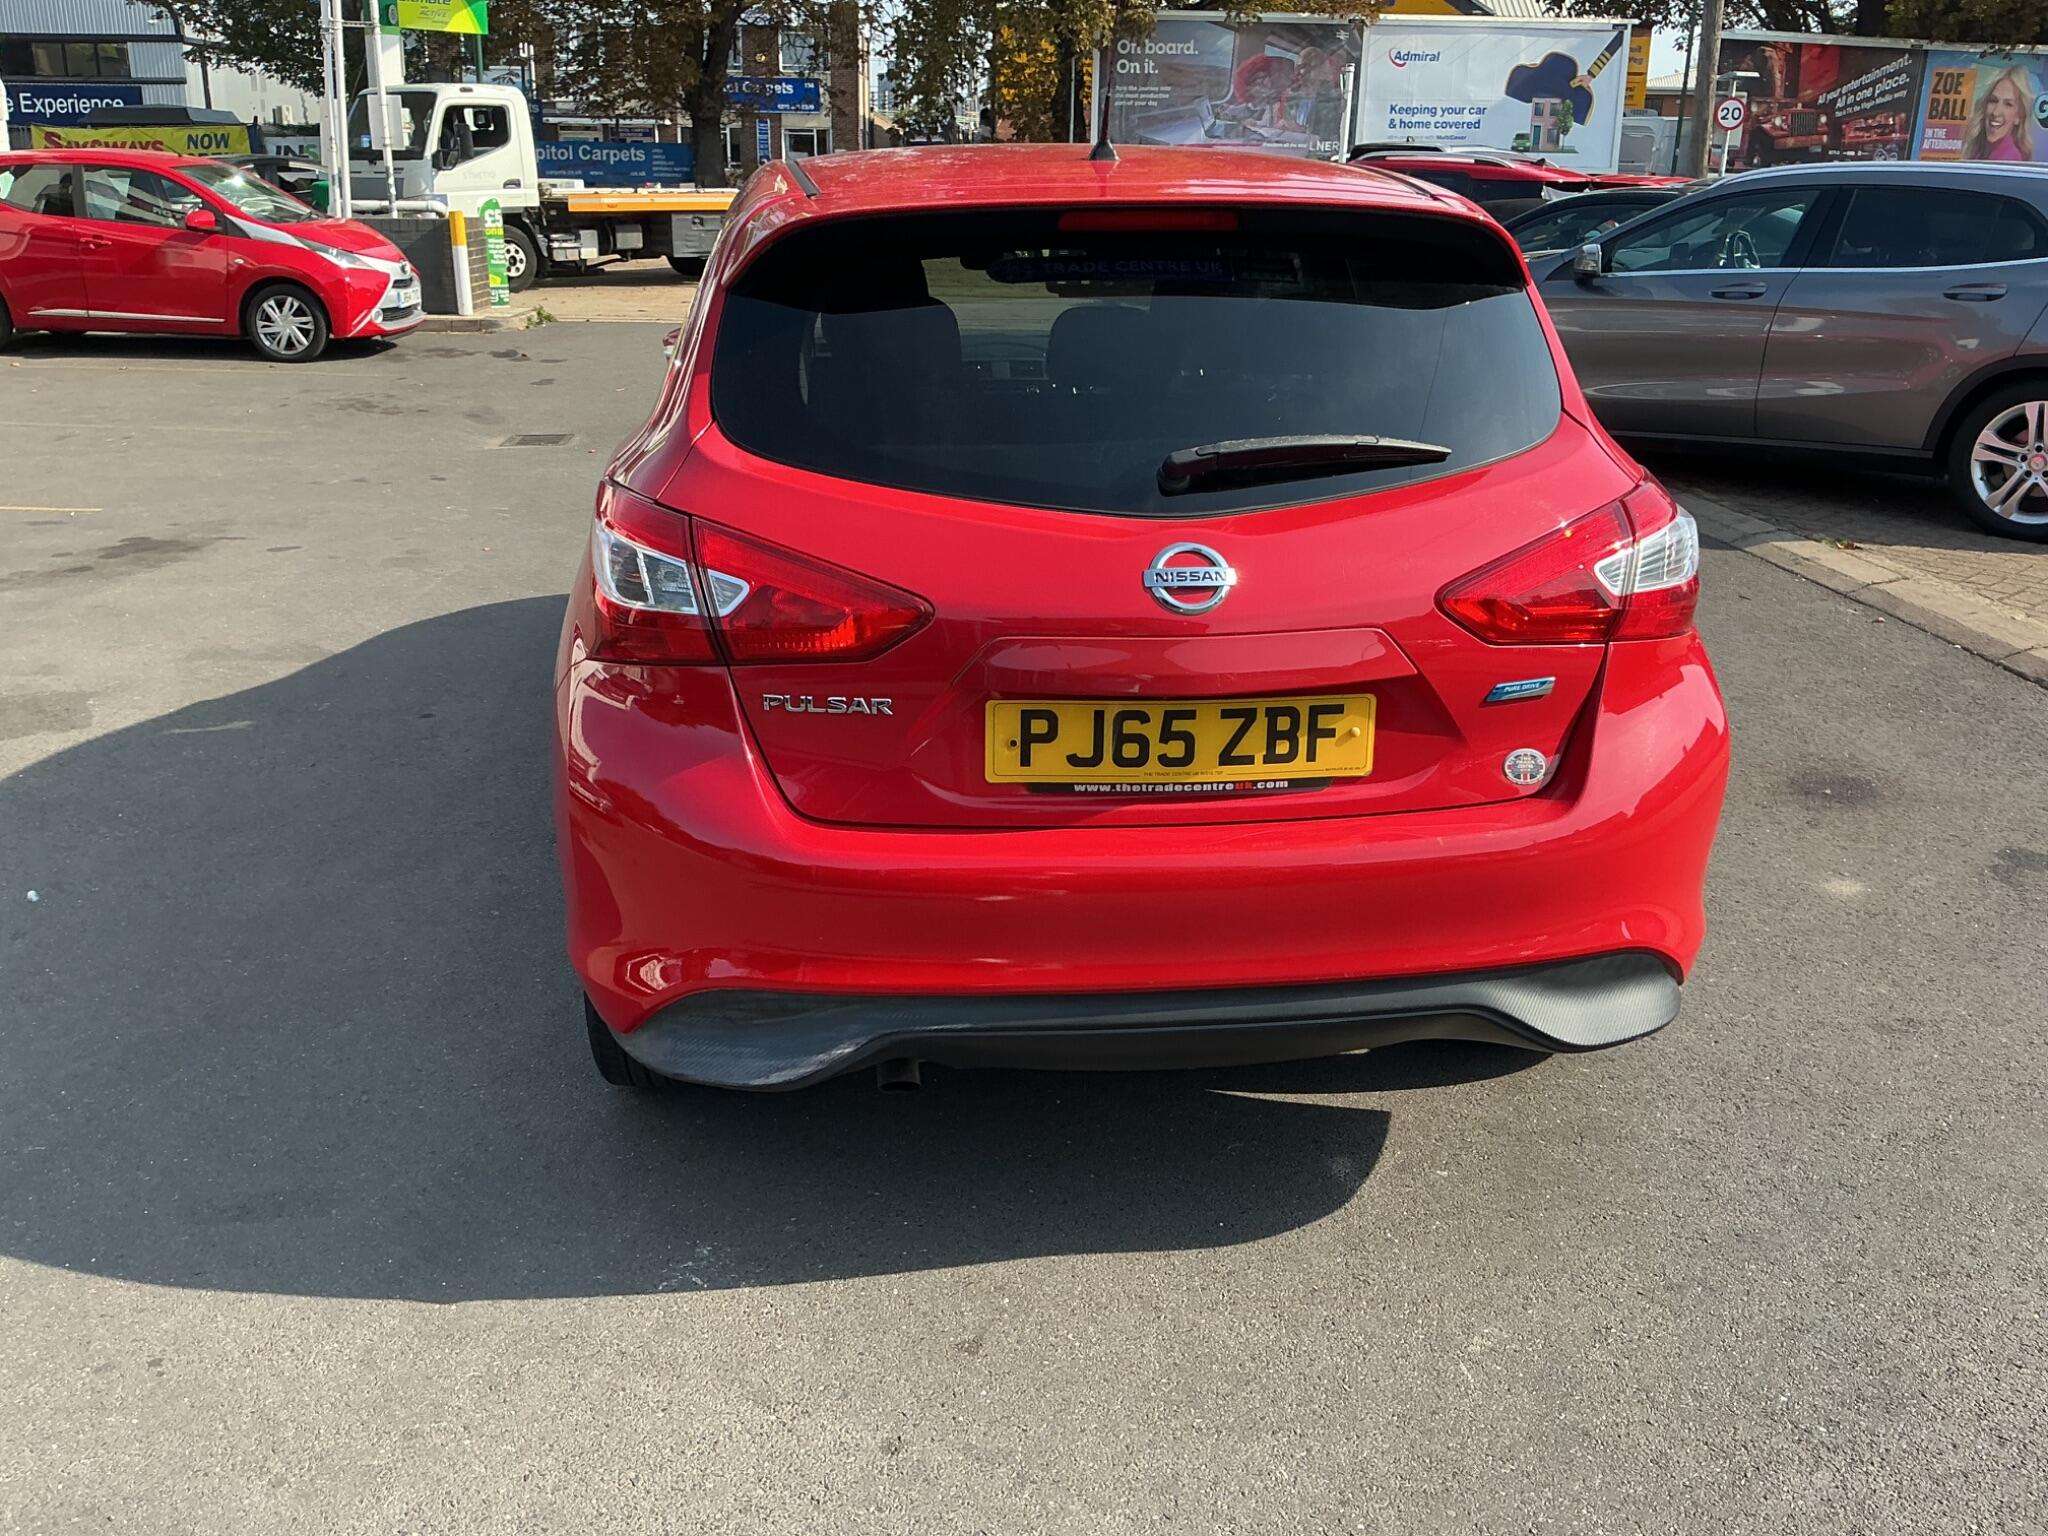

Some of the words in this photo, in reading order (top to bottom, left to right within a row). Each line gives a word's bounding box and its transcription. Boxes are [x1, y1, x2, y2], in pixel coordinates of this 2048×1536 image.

[1117, 39, 1141, 54] On
[1144, 39, 1199, 55] board.
[1394, 50, 1440, 62] Admiral
[1116, 58, 1140, 74] On
[1144, 58, 1159, 74] it.
[1846, 92, 1855, 105] in
[1855, 86, 1873, 101] one
[1874, 72, 1910, 97] place.
[1932, 71, 1965, 95] ZOE
[1389, 104, 1437, 117] Keeping
[1440, 106, 1466, 117] your
[1468, 107, 1487, 115] car
[1720, 107, 1742, 120] 20
[1928, 98, 1967, 121] BALL
[1388, 118, 1397, 129] &
[1399, 119, 1432, 129] home
[1433, 119, 1481, 129] covered
[187, 132, 230, 149] NOW
[1309, 140, 1340, 151] LNER
[537, 145, 573, 164] pitol
[578, 145, 646, 164] Carpets
[1154, 570, 1227, 583] NISSAN
[1503, 685, 1521, 693] PURE
[1522, 682, 1541, 690] DRIVE
[762, 694, 894, 715] PULSAR
[1018, 708, 1198, 768] PJ65
[1217, 703, 1345, 767] ZBF
[1073, 779, 1289, 793] www.thetradecentreuk.com
